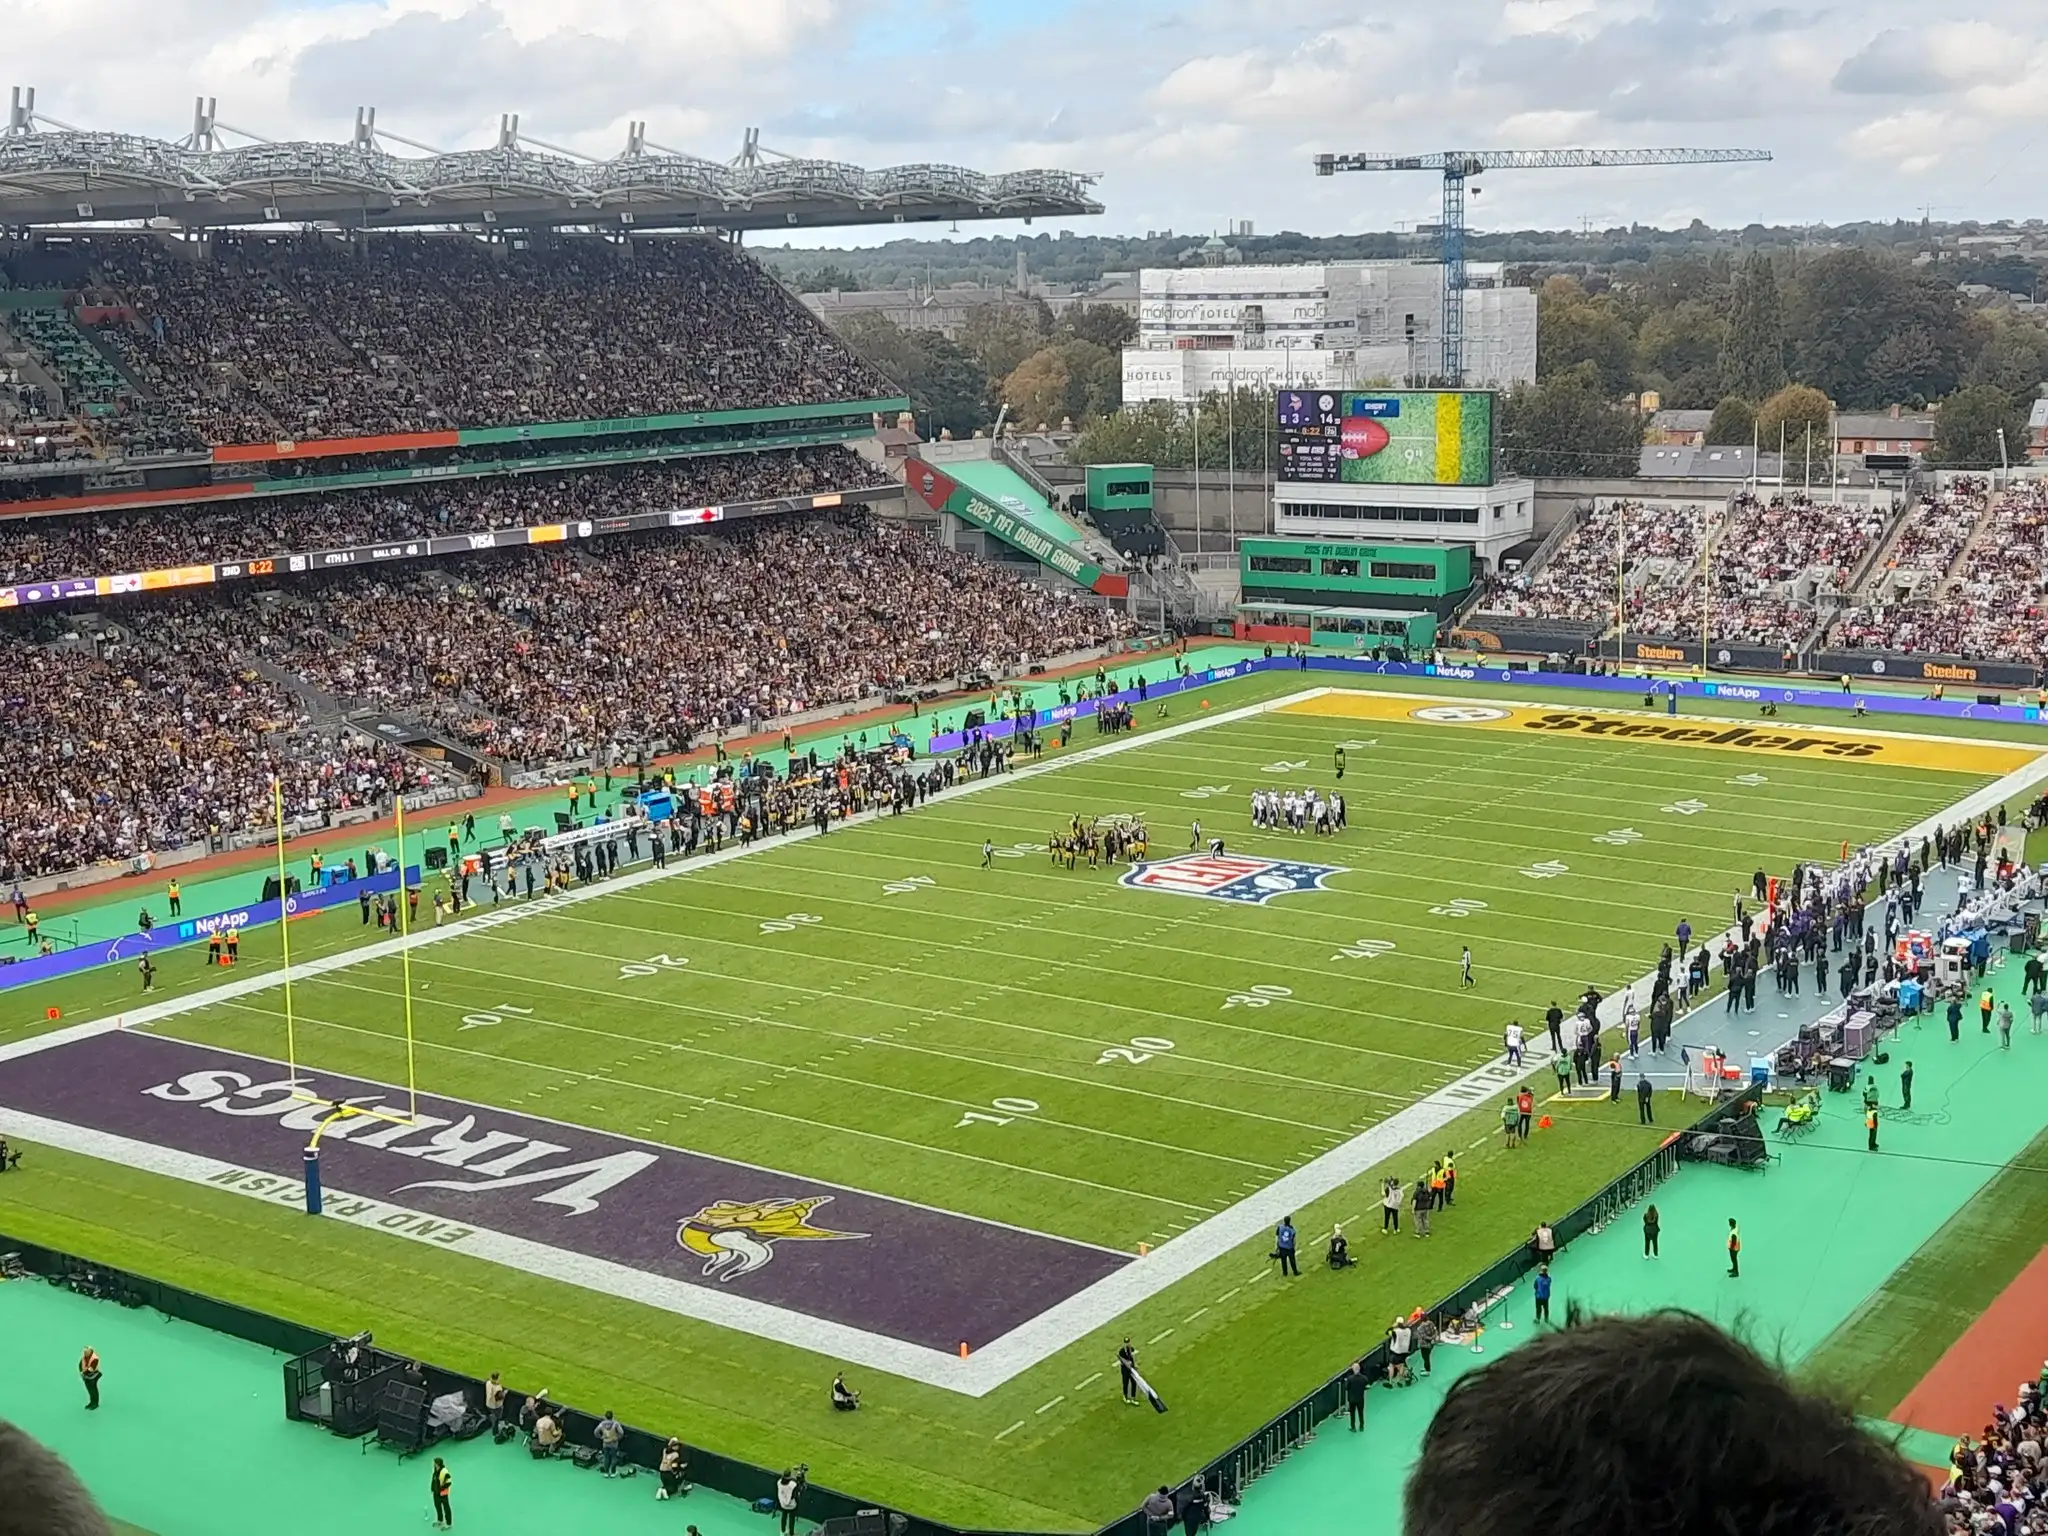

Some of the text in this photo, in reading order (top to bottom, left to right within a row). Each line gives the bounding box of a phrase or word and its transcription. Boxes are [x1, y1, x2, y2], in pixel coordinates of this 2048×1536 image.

[1127, 371, 1172, 381] HOTELS
[1276, 371, 1323, 381] HOTELS
[1291, 414, 1300, 424] 3
[1320, 414, 1333, 424] 14
[468, 533, 496, 549] VISA
[965, 500, 1086, 577] 2025 NFL DUBLIN GAME
[325, 554, 341, 564] 4TH
[372, 549, 390, 558] BALL
[248, 561, 274, 575] 8:22
[51, 584, 60, 598] 3
[1636, 644, 1684, 661] Steelers
[1214, 666, 1236, 680] NetApp
[1436, 663, 1474, 680] NetApp
[1923, 662, 1977, 681] Steelers
[1717, 683, 1760, 700] NetApp
[1051, 707, 1077, 720] NetApp
[1523, 713, 1883, 757] Steelers
[1428, 899, 1489, 918] 50
[196, 911, 249, 938] NetApp
[1338, 939, 1397, 959] 40
[620, 953, 690, 977] 20
[1226, 984, 1293, 1008] 30
[462, 1003, 534, 1027] 10
[1102, 1036, 1176, 1065] 20
[964, 1097, 1040, 1127] 10
[378, 1212, 475, 1246] END
